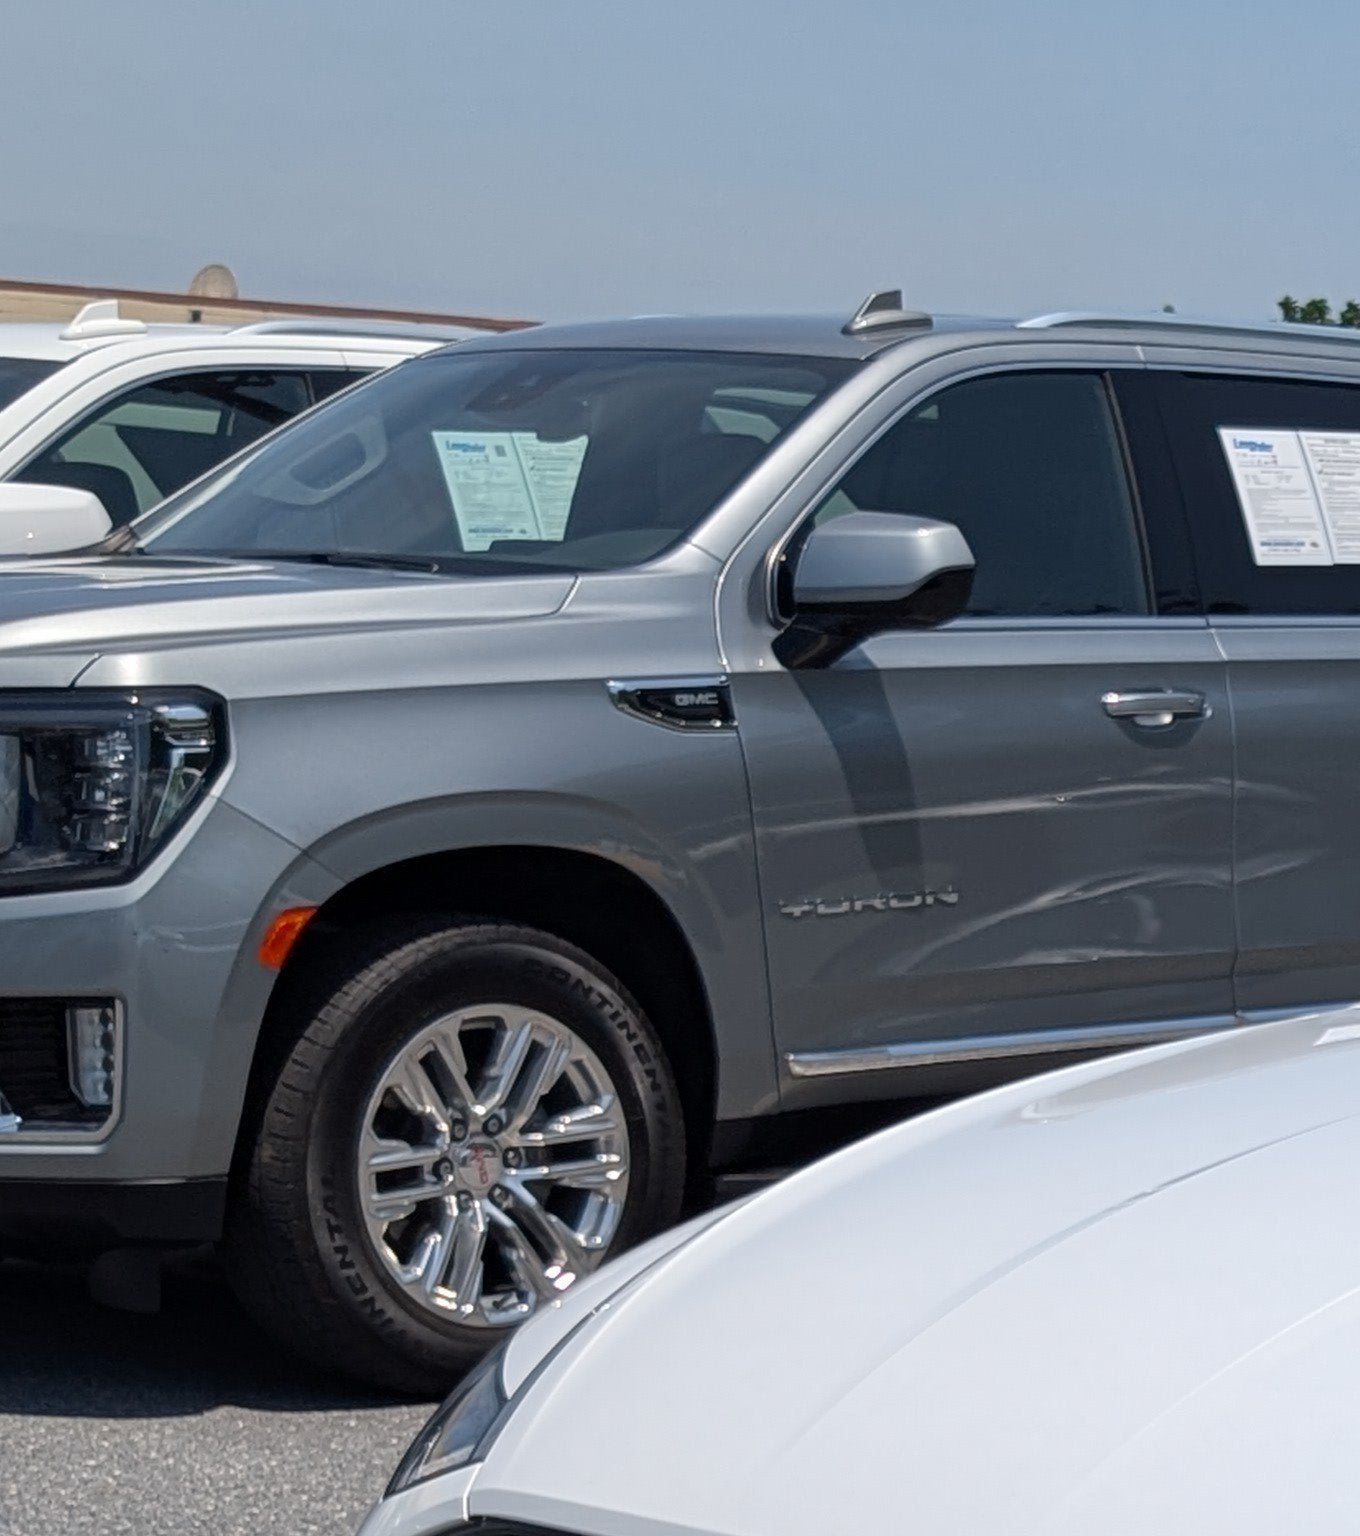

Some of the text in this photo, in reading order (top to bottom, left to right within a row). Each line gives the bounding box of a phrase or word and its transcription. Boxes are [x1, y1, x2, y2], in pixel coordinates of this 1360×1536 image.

[674, 692, 719, 706] GMC
[778, 886, 959, 918] YUKON
[525, 958, 671, 1151] CONTINENT
